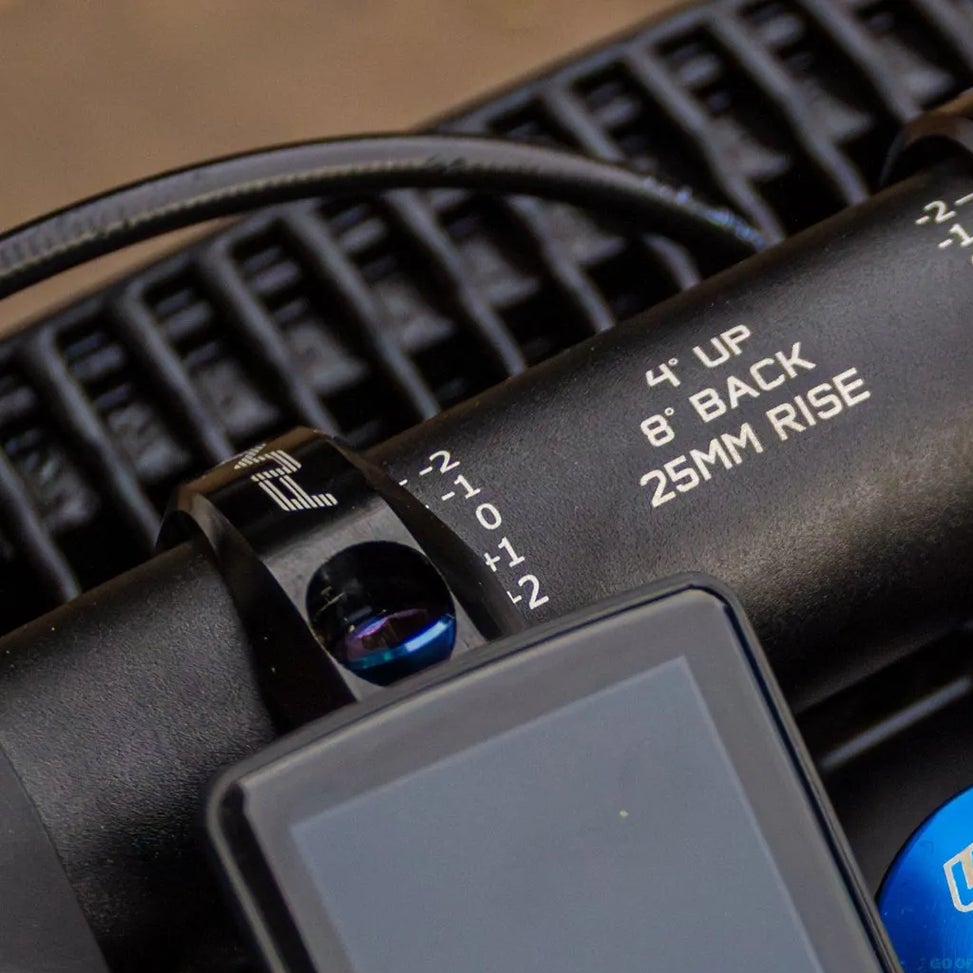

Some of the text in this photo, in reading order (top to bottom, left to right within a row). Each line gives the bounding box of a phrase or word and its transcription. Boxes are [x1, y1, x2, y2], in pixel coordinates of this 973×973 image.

[915, 200, 956, 224] -2
[692, 324, 751, 368] UP
[688, 341, 817, 423] BACK
[639, 367, 871, 508] 25MM RISE
[419, 450, 461, 476] -2
[441, 474, 481, 501] -1
[475, 503, 502, 530] 0
[484, 537, 525, 572] +1
